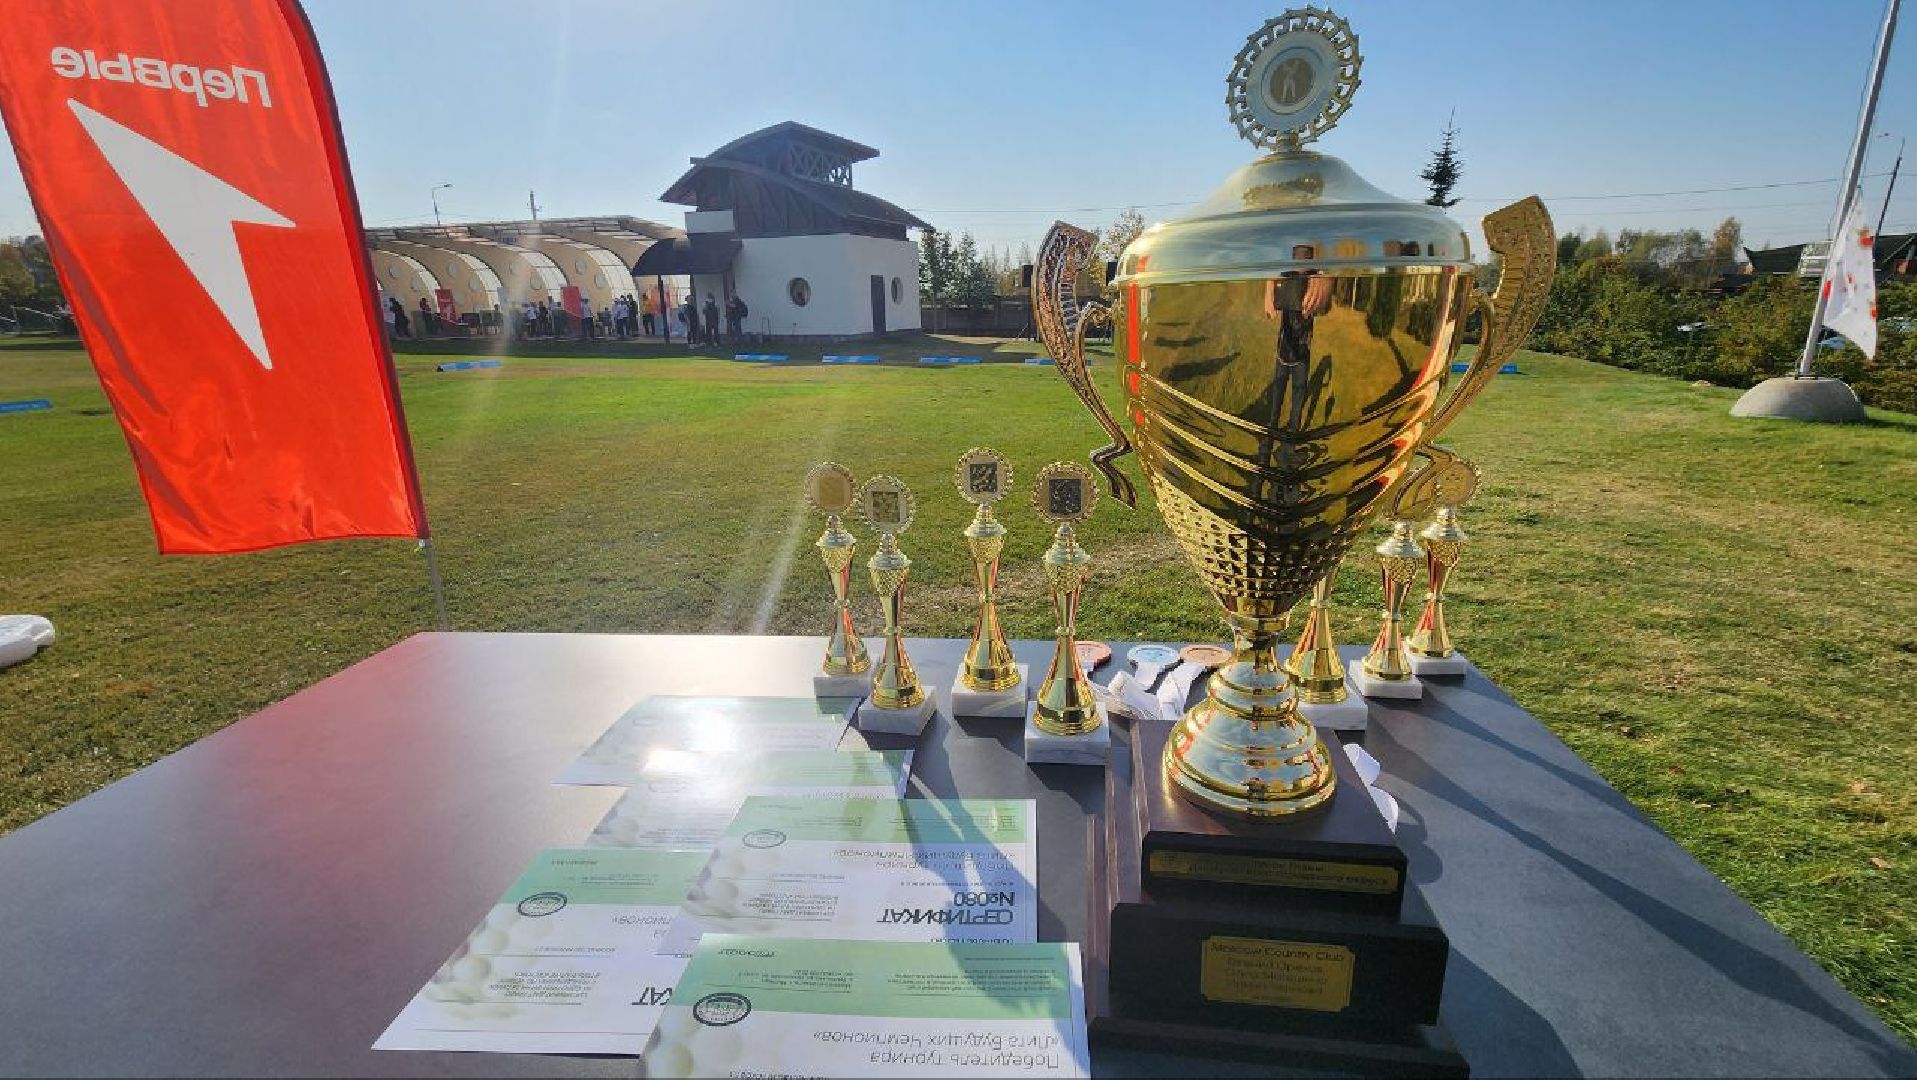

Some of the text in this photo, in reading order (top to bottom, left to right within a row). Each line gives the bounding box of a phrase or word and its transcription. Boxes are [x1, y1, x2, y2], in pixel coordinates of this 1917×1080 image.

[953, 891, 1015, 906] №080
[877, 908, 1014, 924] СЕРТИФИКАТ
[1315, 951, 1344, 962] Club
[870, 1051, 1059, 1069] Победитель турнира
